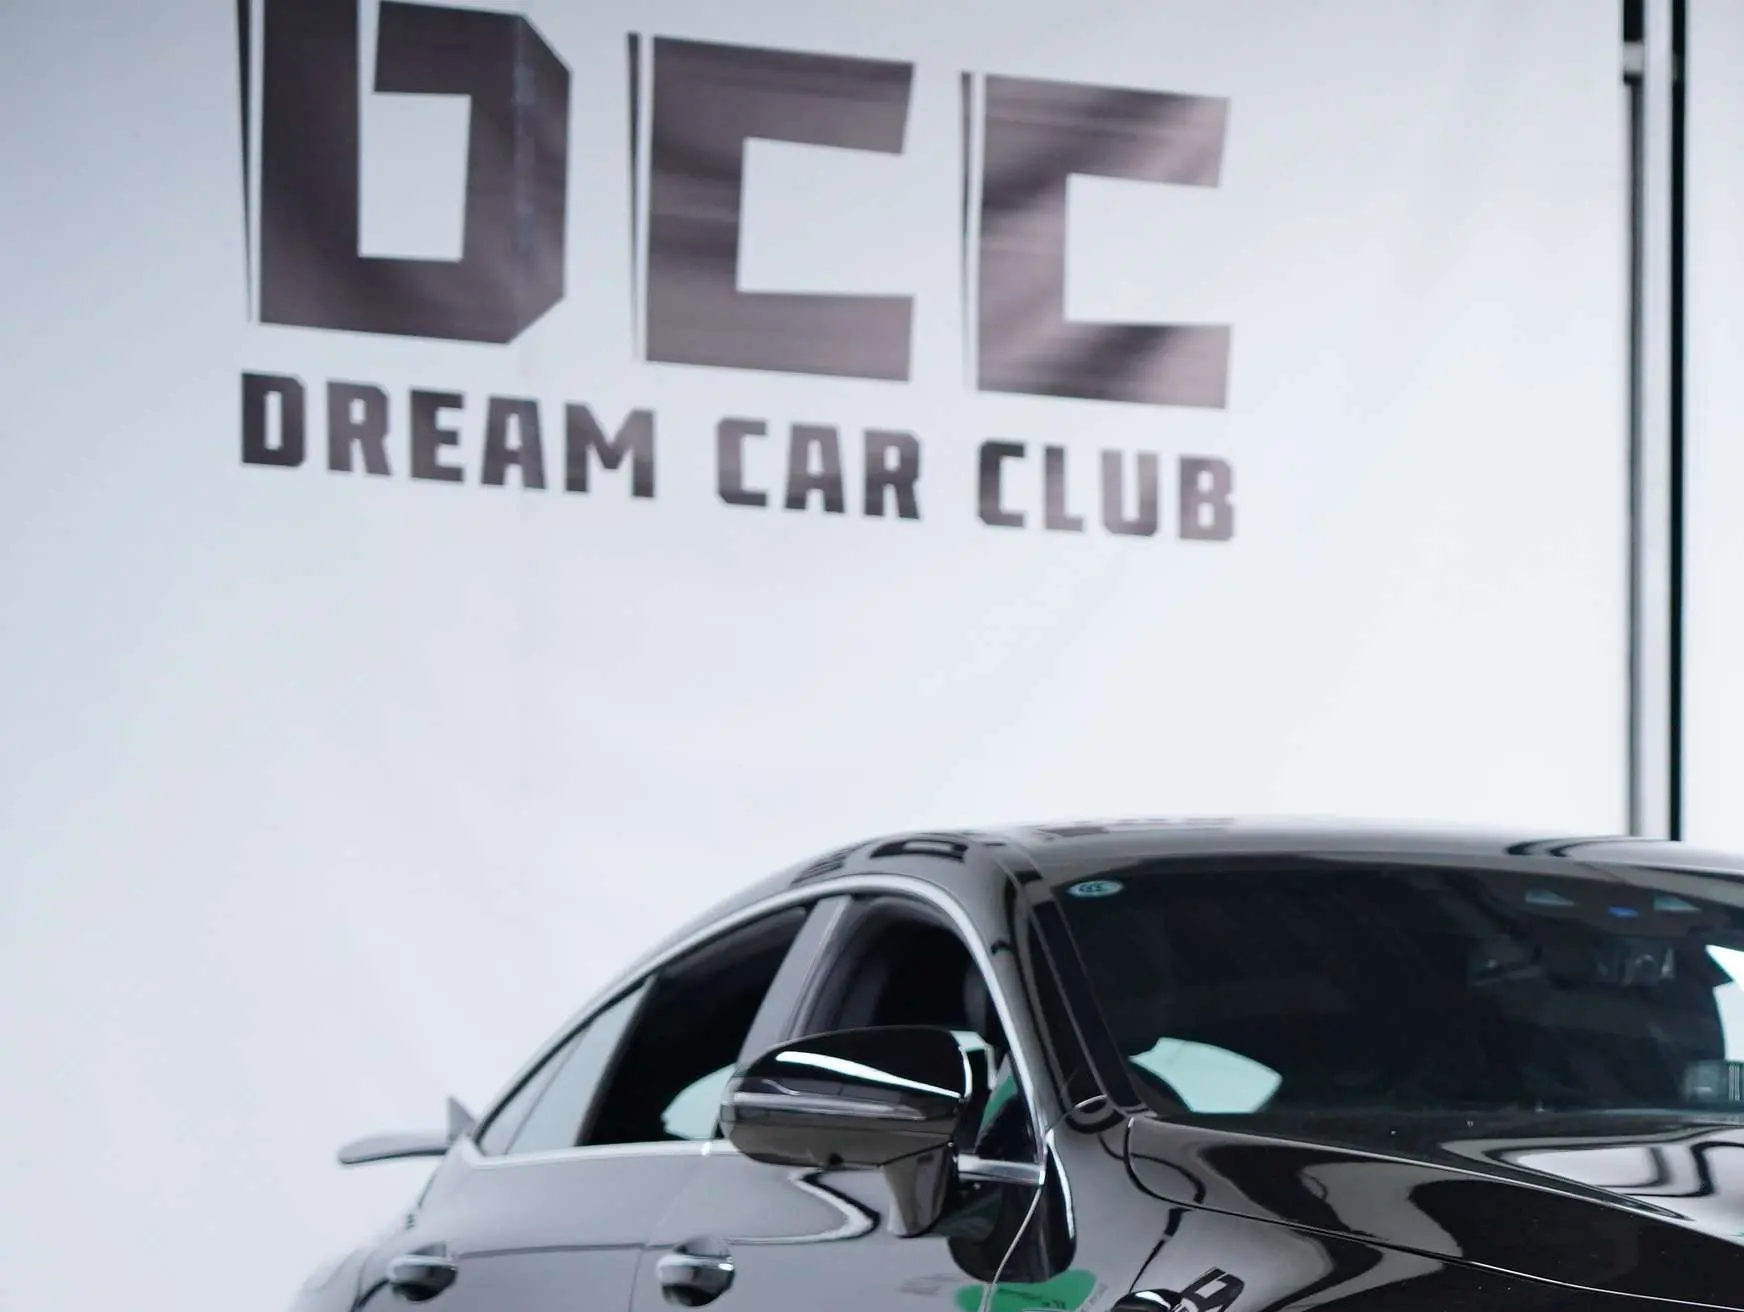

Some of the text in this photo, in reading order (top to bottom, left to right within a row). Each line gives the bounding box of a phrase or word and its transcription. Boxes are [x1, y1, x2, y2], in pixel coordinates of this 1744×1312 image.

[232, 0, 1233, 410] DCC
[240, 371, 1236, 543] DREAM CAR CLUB
